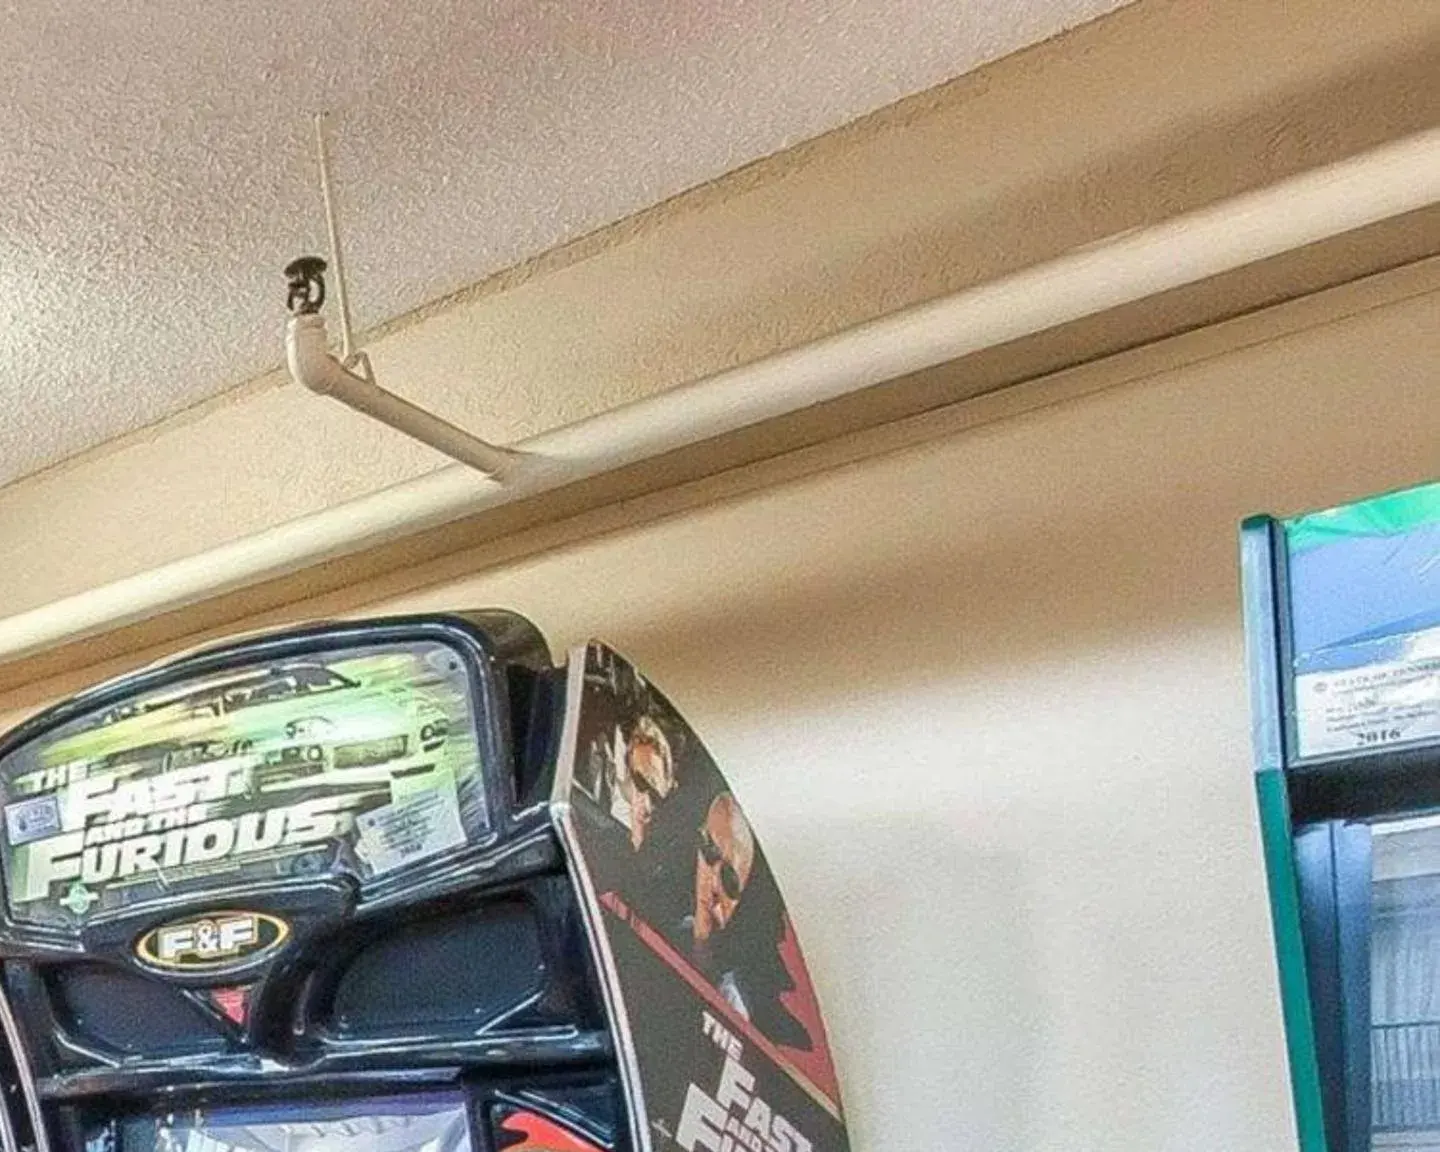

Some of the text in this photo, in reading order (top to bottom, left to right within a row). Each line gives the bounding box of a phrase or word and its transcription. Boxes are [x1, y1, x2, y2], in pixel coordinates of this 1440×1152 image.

[1356, 727, 1401, 746] 2016
[14, 762, 91, 793] THE
[62, 757, 254, 832] FAST
[27, 797, 340, 901] FURIOUS
[159, 917, 254, 959] F&F
[702, 1010, 744, 1061] THE
